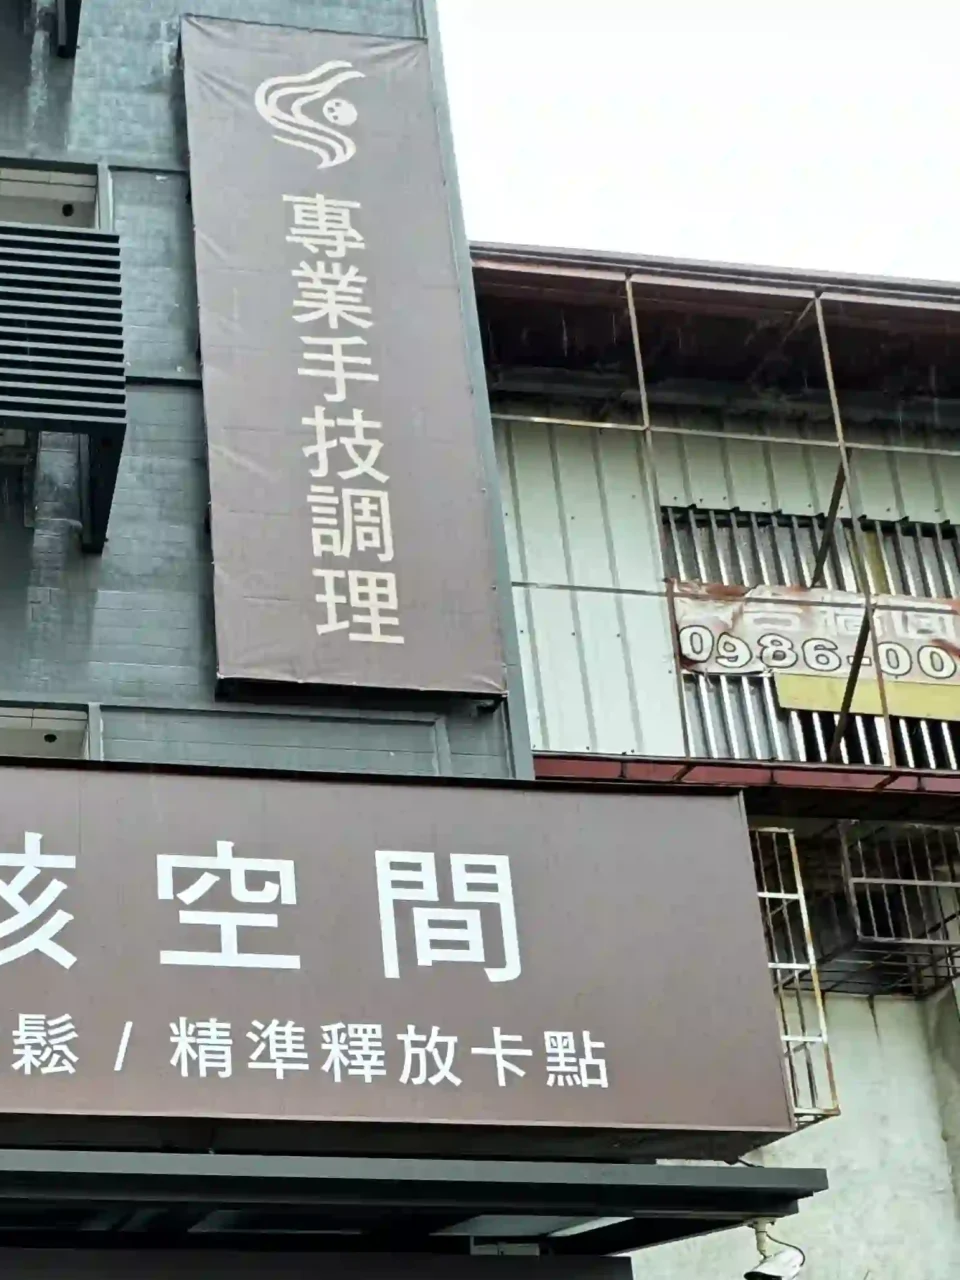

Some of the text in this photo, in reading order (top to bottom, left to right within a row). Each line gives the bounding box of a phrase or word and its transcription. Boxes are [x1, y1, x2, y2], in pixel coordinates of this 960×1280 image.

[281, 193, 405, 645] 專業手技調理
[679, 624, 957, 680] 0986-00
[168, 1016, 609, 1090] 精準釋放卡點
